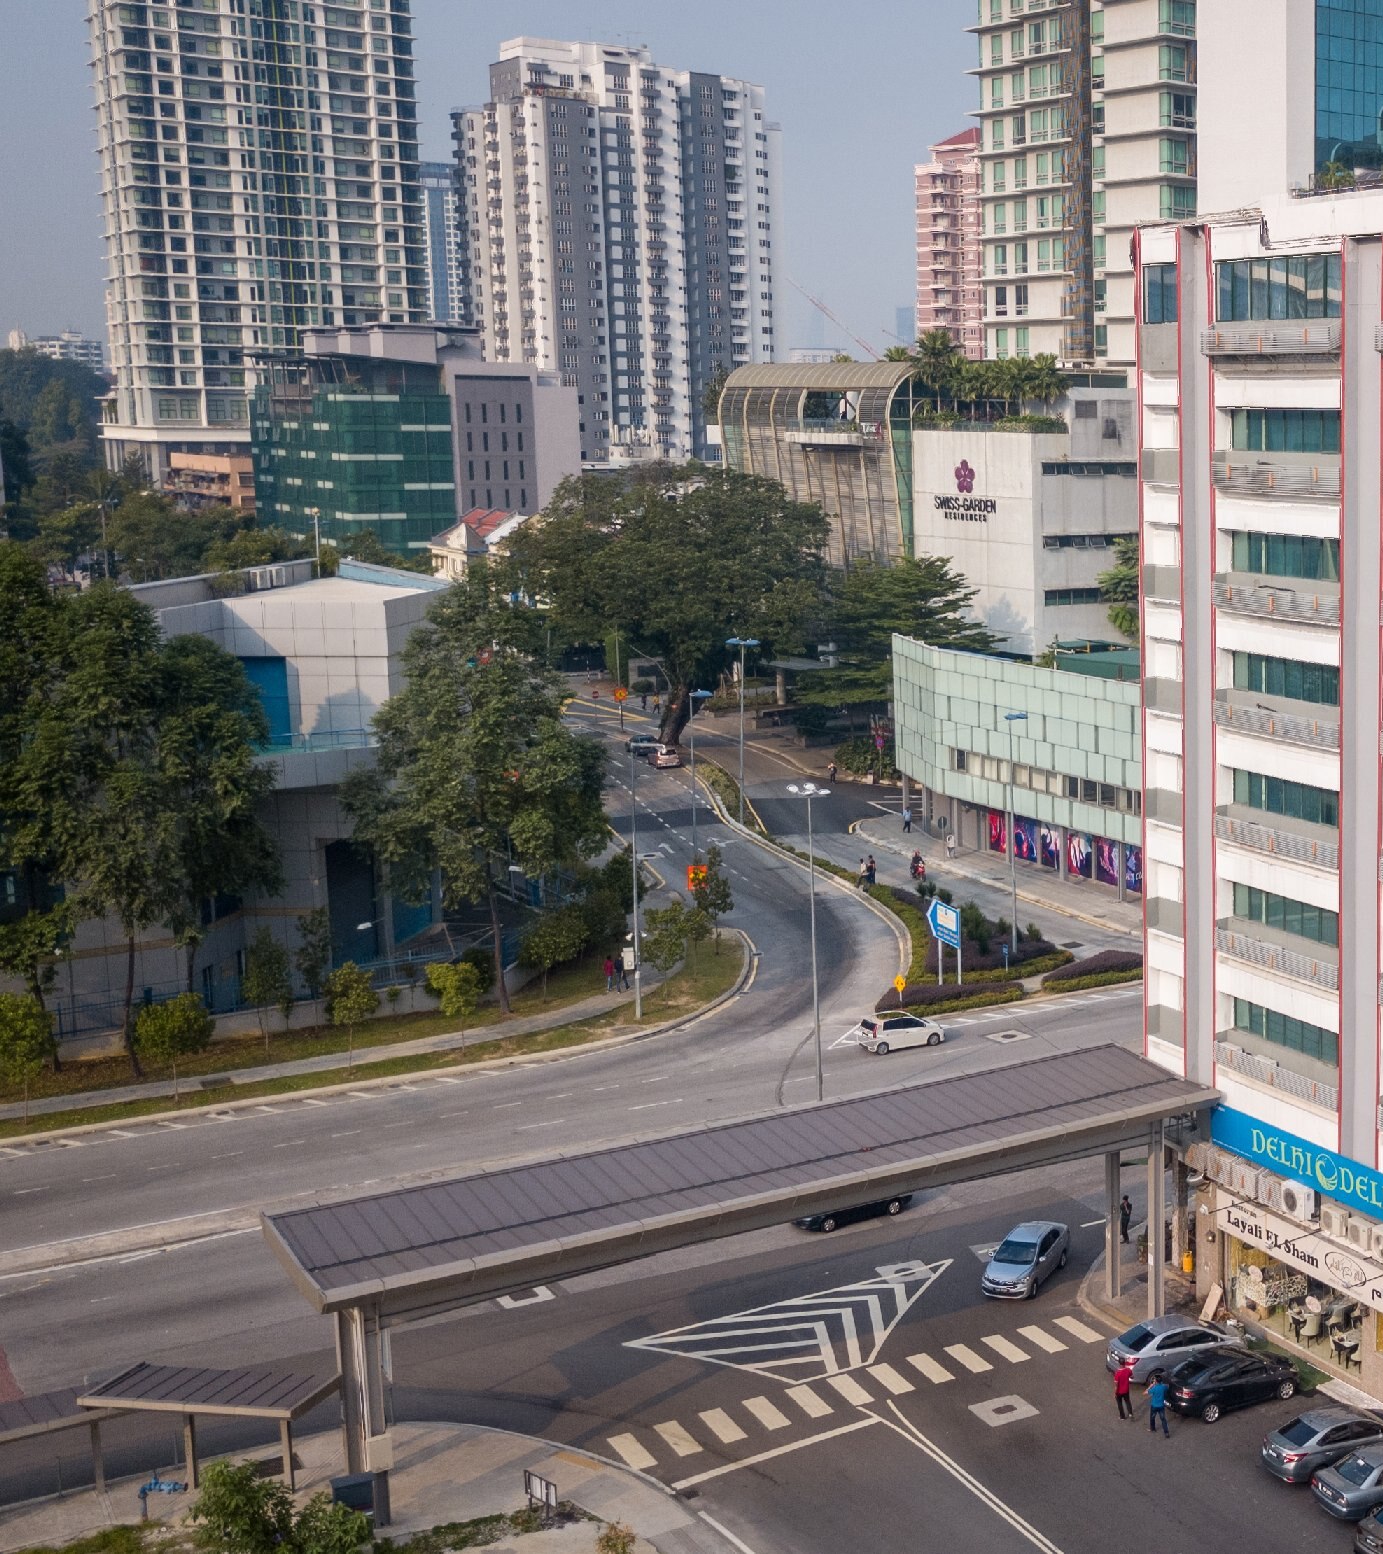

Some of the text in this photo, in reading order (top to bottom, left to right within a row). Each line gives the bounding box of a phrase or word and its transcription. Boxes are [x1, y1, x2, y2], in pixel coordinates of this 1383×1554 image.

[934, 494, 997, 514] SWISS-GARDEN
[944, 511, 988, 522] RESIDENCES
[1227, 1209, 1263, 1240] Layali
[1283, 1239, 1319, 1268] Sham
